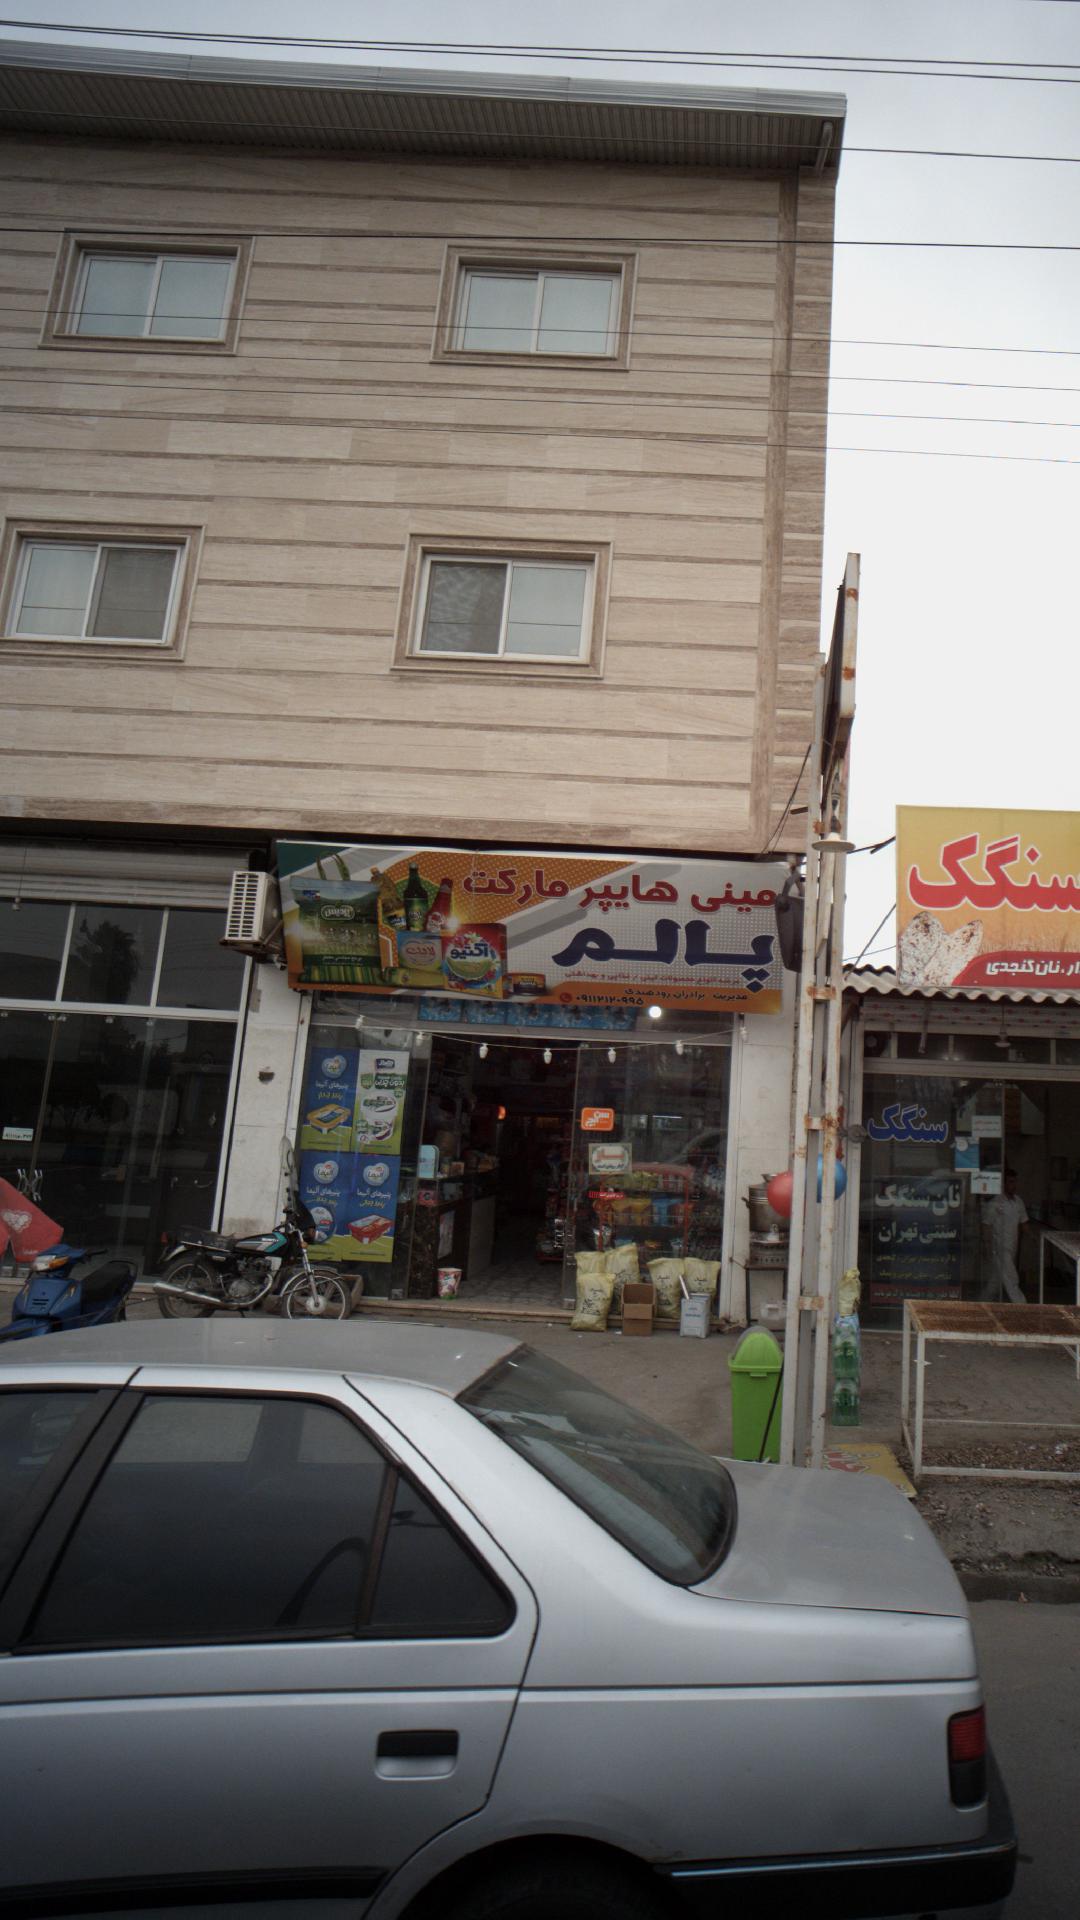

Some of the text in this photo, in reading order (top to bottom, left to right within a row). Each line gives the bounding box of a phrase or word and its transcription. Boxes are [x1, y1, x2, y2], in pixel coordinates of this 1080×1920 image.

[463, 868, 777, 912] مینی هایپر مارکت
[552, 918, 775, 993] پالم
[986, 959, 1034, 976] کنجدی
[1035, 960, 1060, 976] نان
[867, 1103, 948, 1143] سنگک
[875, 1183, 961, 1216] نان سنگک
[878, 1221, 957, 1244] سنتی تهران
